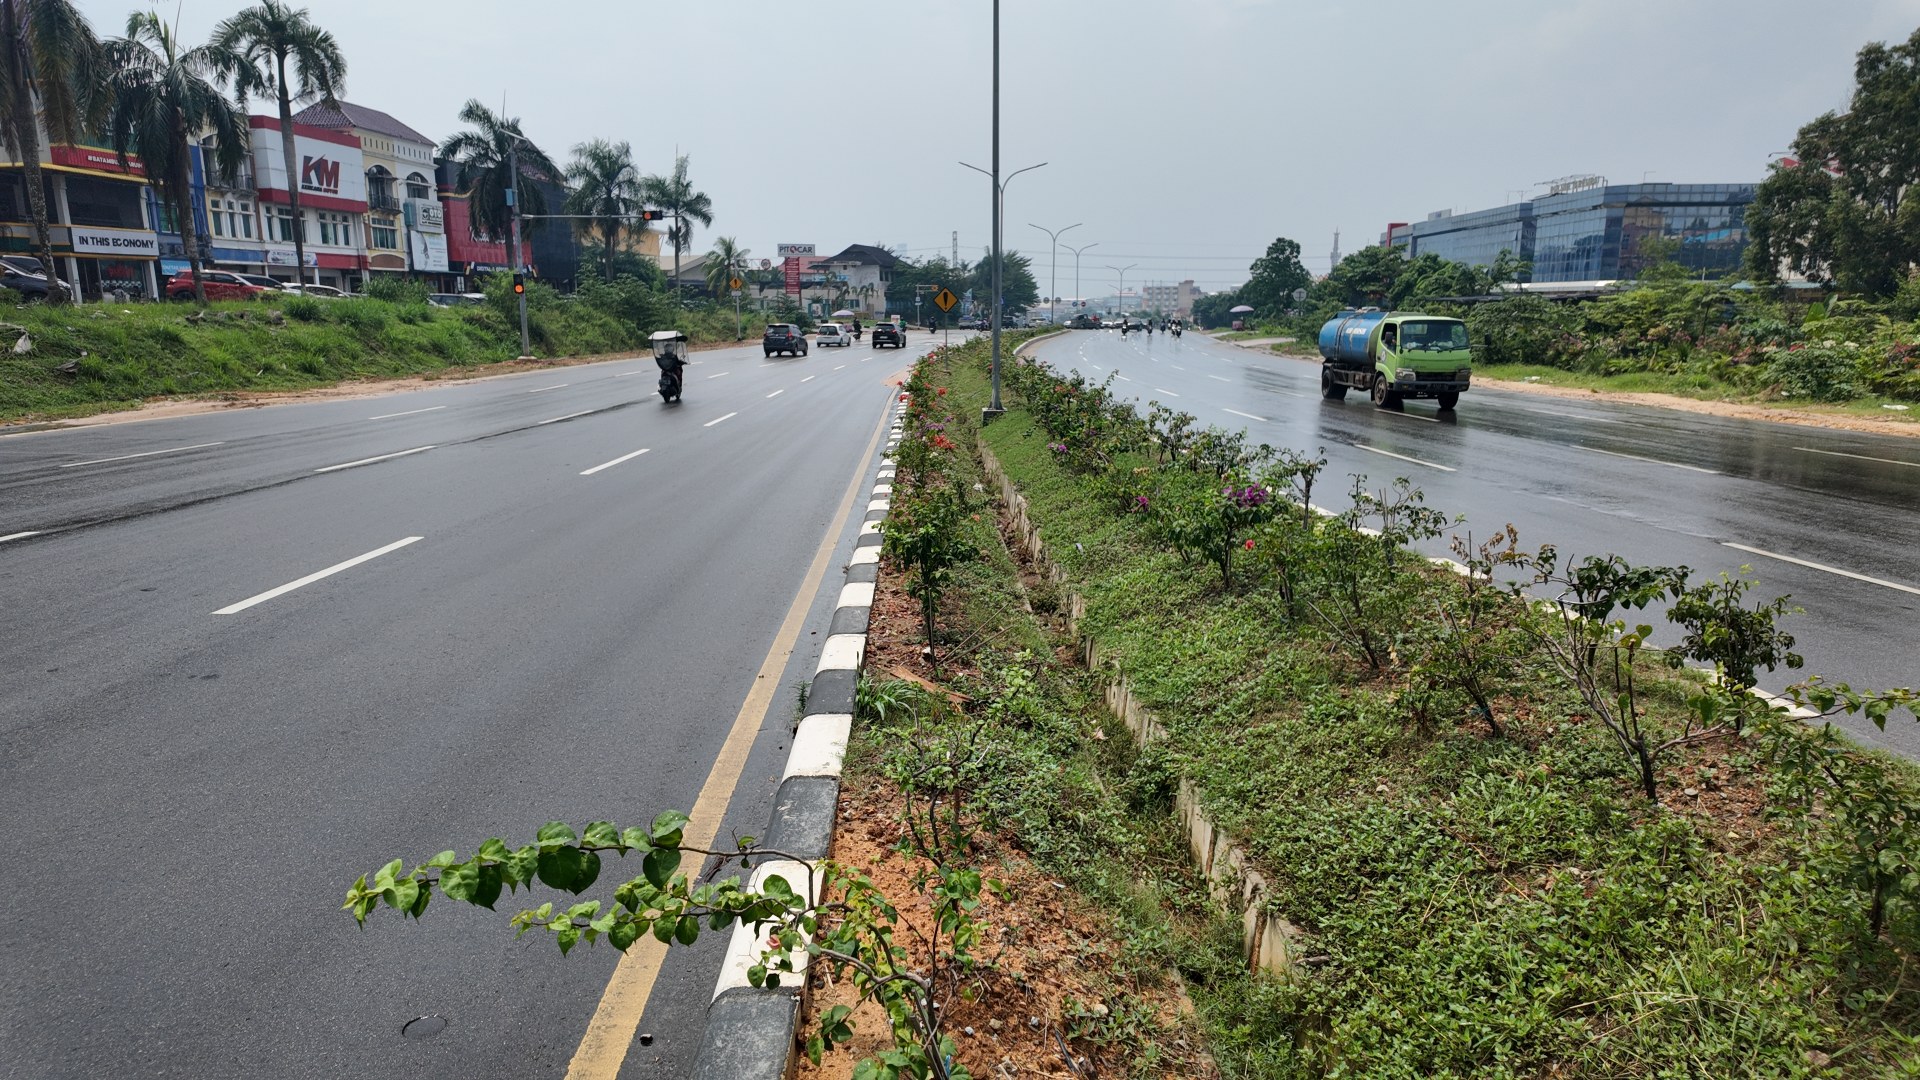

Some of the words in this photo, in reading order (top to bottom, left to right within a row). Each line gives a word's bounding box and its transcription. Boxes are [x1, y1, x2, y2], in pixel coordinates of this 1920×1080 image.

[301, 154, 340, 189] KM
[429, 208, 442, 218] OTO
[79, 236, 88, 245] IN
[90, 237, 110, 246] THIS
[112, 238, 154, 248] ECONOMY
